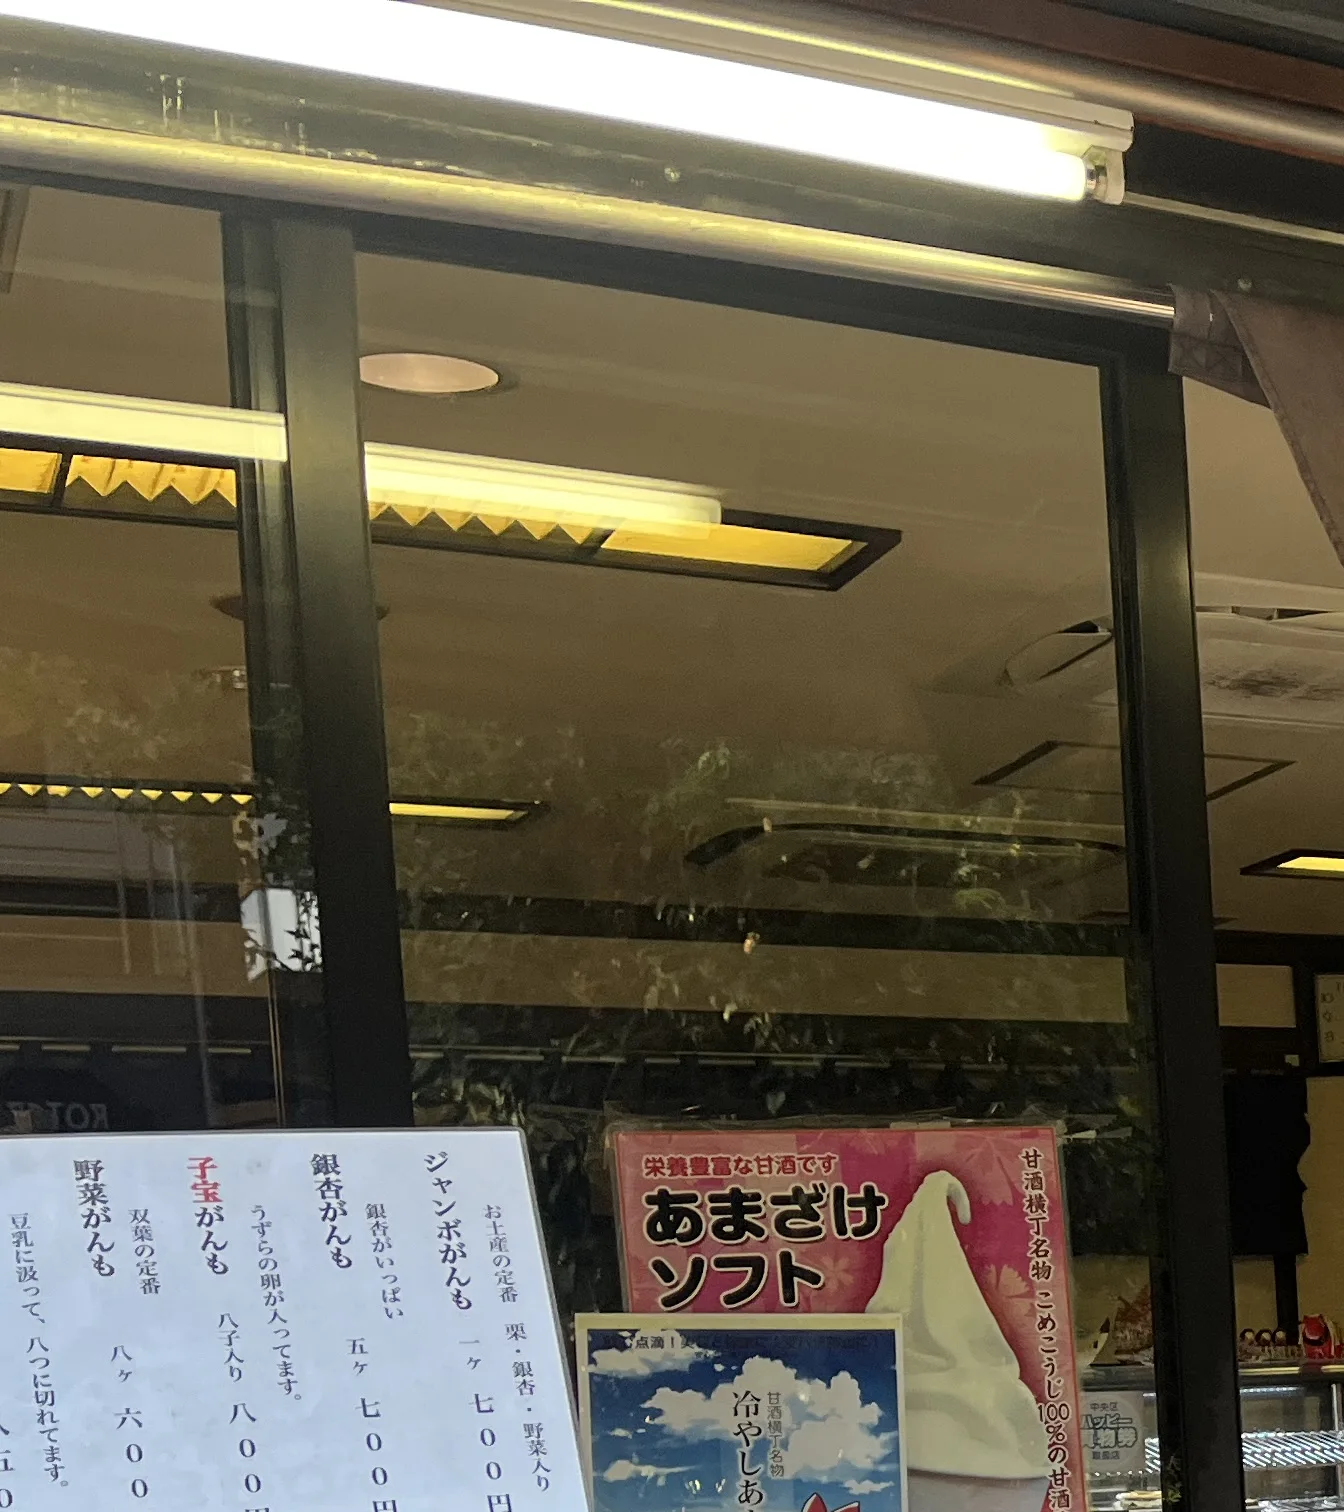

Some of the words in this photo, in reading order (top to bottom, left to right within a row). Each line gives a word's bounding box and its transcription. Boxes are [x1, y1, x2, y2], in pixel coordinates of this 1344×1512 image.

[72, 1159, 115, 1277] 野菜がんも
[187, 1156, 229, 1276] 子宝がんも
[310, 1153, 352, 1269] 銀杏がんも
[643, 1153, 839, 1179] 栄養豊富な甘酒です
[643, 1182, 889, 1245] あまざけ
[1020, 1147, 1055, 1282] 甘酒横丁名物
[128, 1208, 161, 1295] 双葉の定番
[365, 1203, 404, 1319] 銀杏がいっぱい
[423, 1151, 473, 1311] ジャンボがんも
[484, 1205, 518, 1303] お土産の定番
[650, 1250, 826, 1311] ソフト
[250, 1205, 302, 1401] うずらの卵が入ってます。
